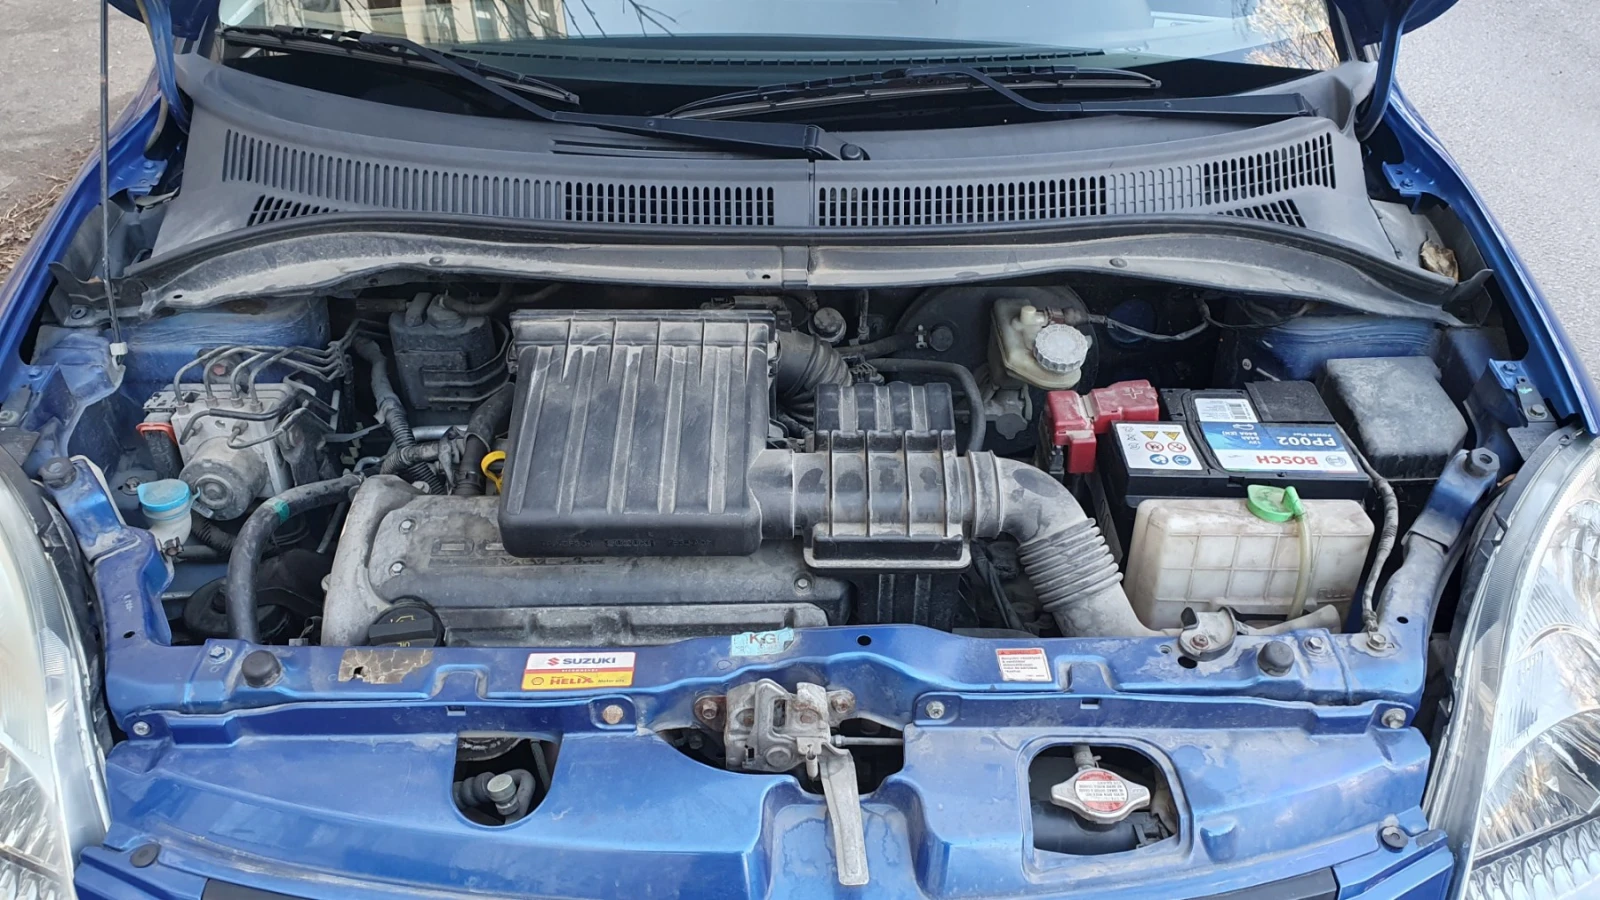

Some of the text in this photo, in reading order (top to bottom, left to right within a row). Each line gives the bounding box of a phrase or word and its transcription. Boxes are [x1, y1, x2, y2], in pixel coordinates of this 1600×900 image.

[1276, 436, 1337, 447] PP002
[1256, 455, 1318, 465] BOSCH
[550, 676, 594, 685] HELIX
